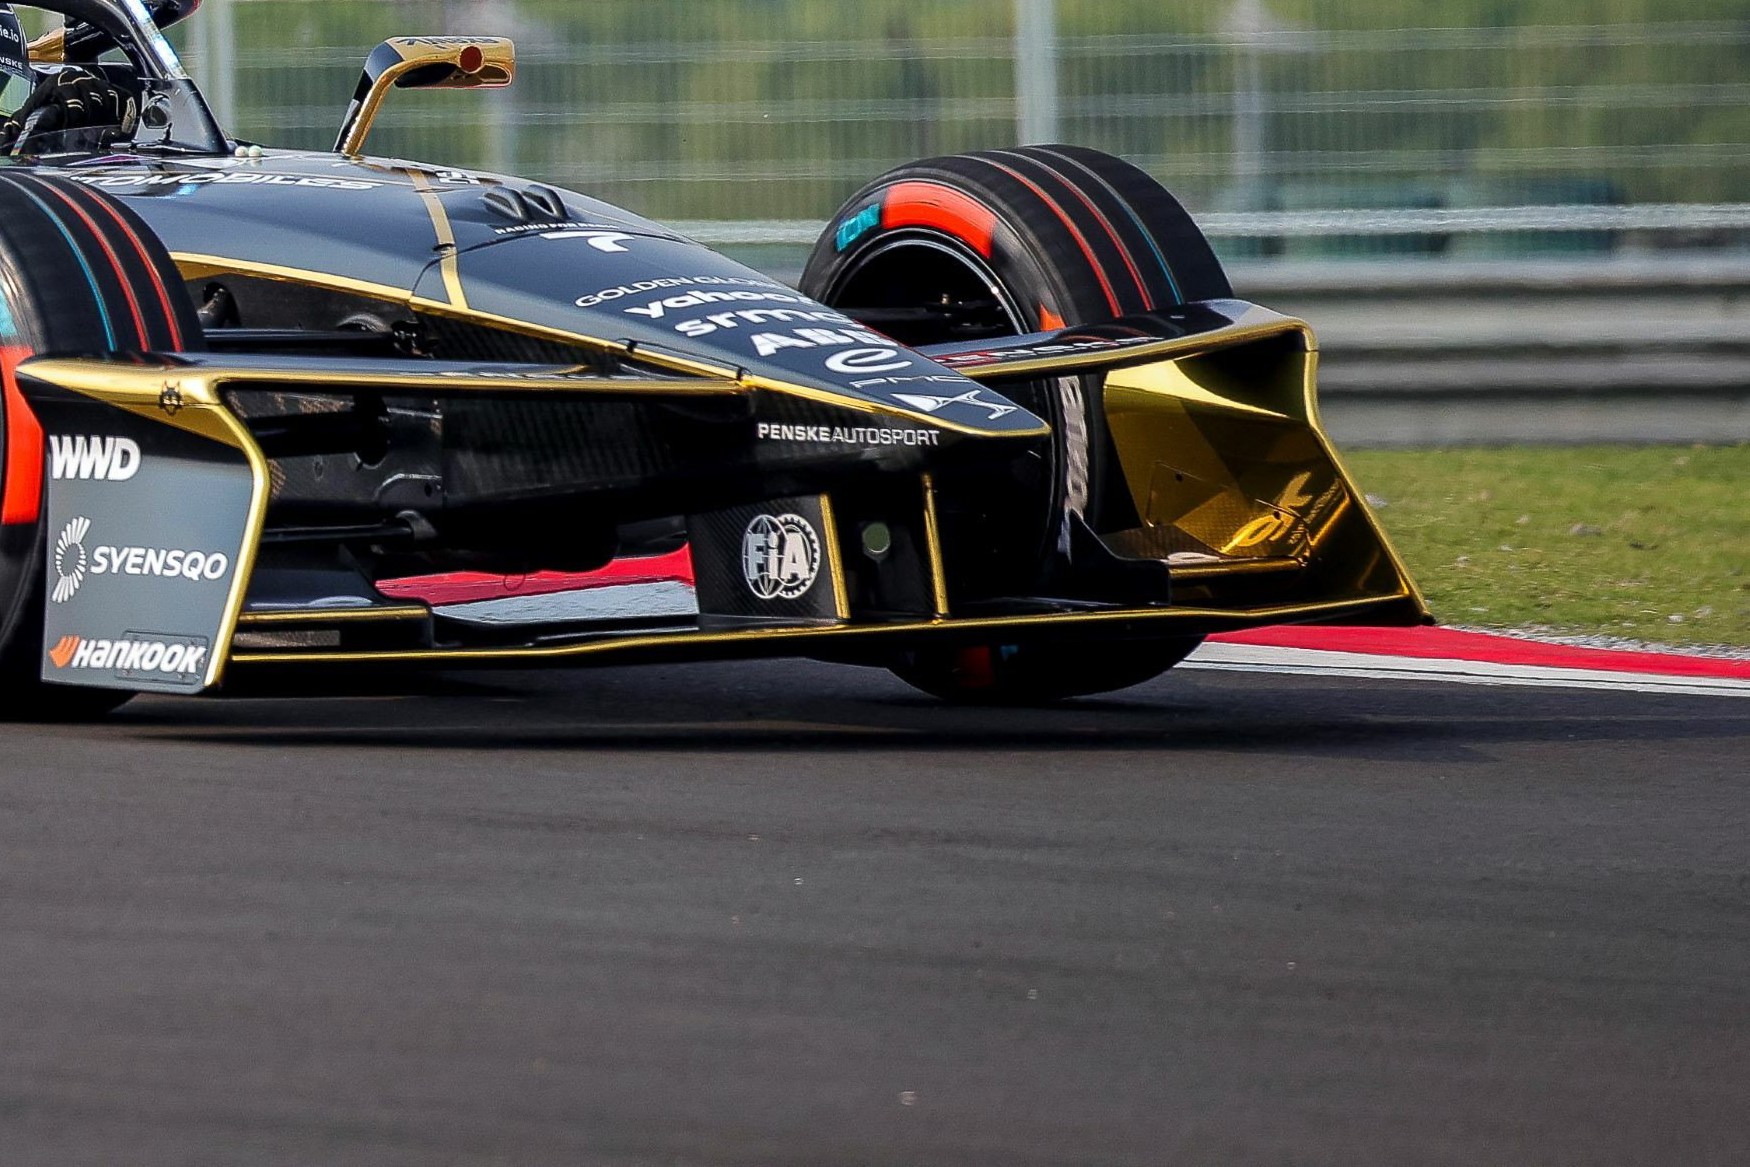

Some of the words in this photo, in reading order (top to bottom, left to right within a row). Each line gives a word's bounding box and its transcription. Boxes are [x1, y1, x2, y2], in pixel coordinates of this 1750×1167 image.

[574, 275, 691, 307] GOLDEN
[50, 435, 142, 481] WWD
[90, 545, 229, 581] SYENSQO
